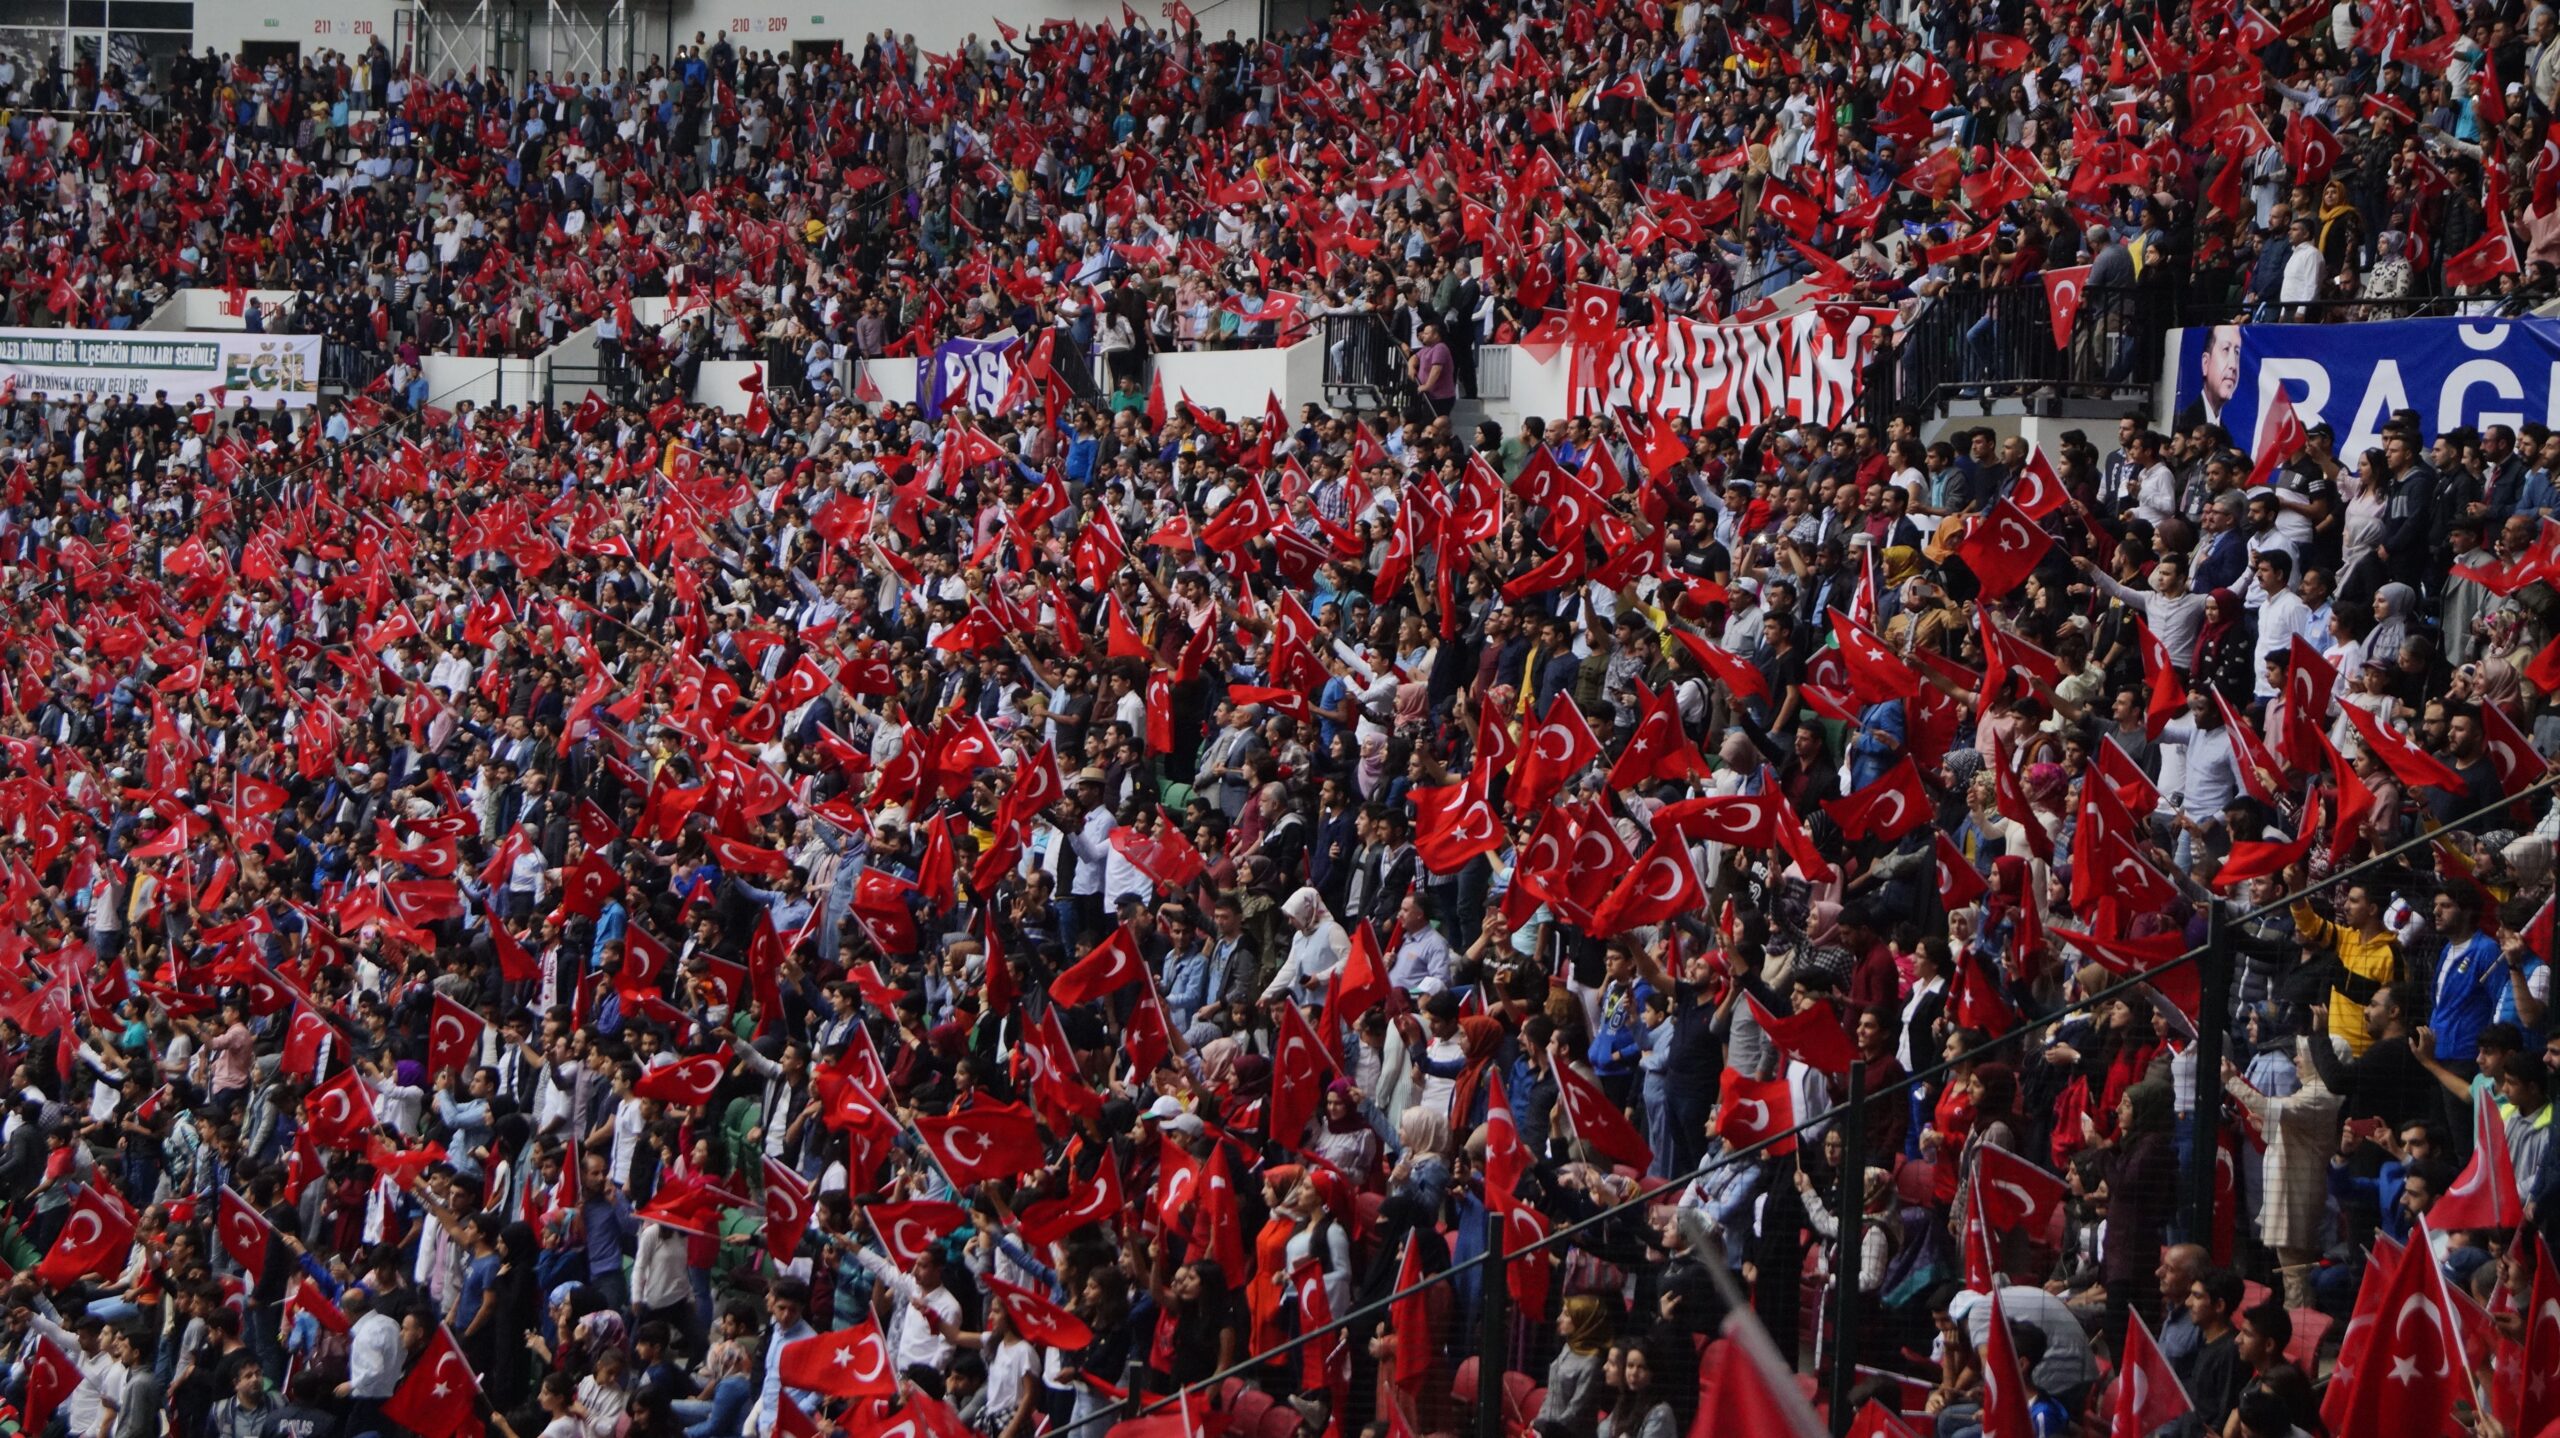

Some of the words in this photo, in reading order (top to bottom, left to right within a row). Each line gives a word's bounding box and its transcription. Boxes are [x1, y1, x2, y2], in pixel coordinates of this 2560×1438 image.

[1162, 2, 1174, 18] 20
[315, 20, 332, 33] 211
[354, 20, 373, 34] 210
[732, 18, 750, 32] 210
[768, 17, 788, 31] 209
[219, 301, 231, 316] 10
[0, 341, 20, 360] LER
[22, 338, 54, 361] DİYARI
[55, 340, 77, 362] EĞİL
[79, 340, 129, 366] İLÇEMİZİN
[131, 345, 174, 365] DUALARI
[175, 343, 217, 367] SENİNLE
[227, 342, 318, 392] EĞİL
